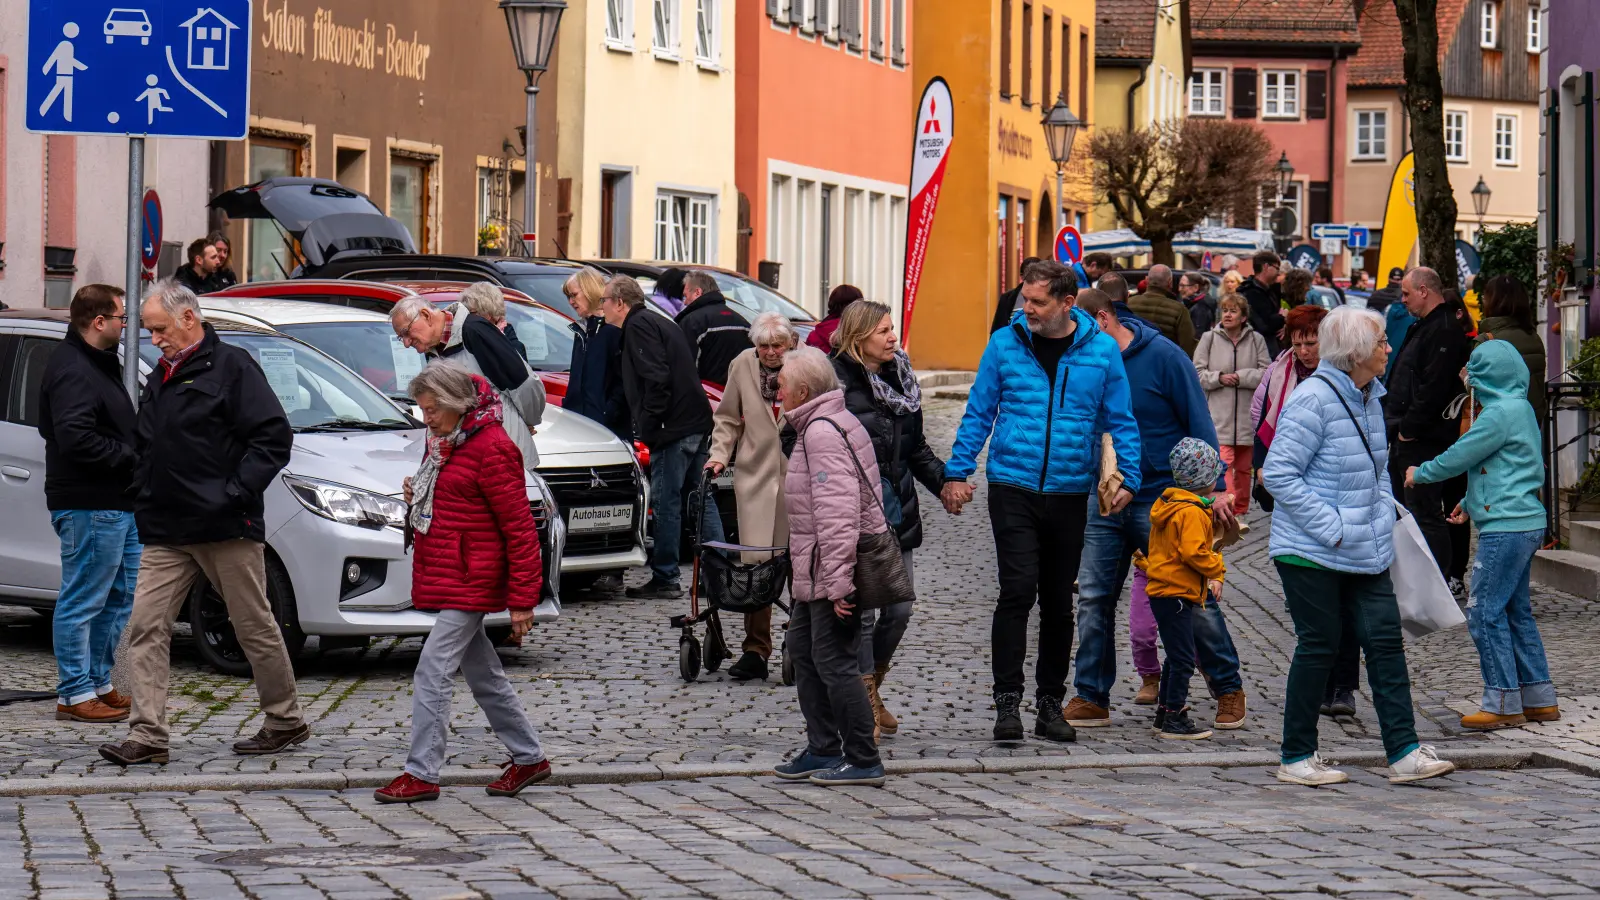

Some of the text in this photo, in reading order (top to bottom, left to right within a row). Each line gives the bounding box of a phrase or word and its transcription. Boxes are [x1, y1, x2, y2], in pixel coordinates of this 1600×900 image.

[262, 0, 306, 55] Salon
[919, 138, 945, 148] MITSUBISHI
[922, 148, 942, 159] MOTORS
[905, 192, 932, 290] Autohaus Lang
[572, 507, 631, 520] Autohaus Lang
